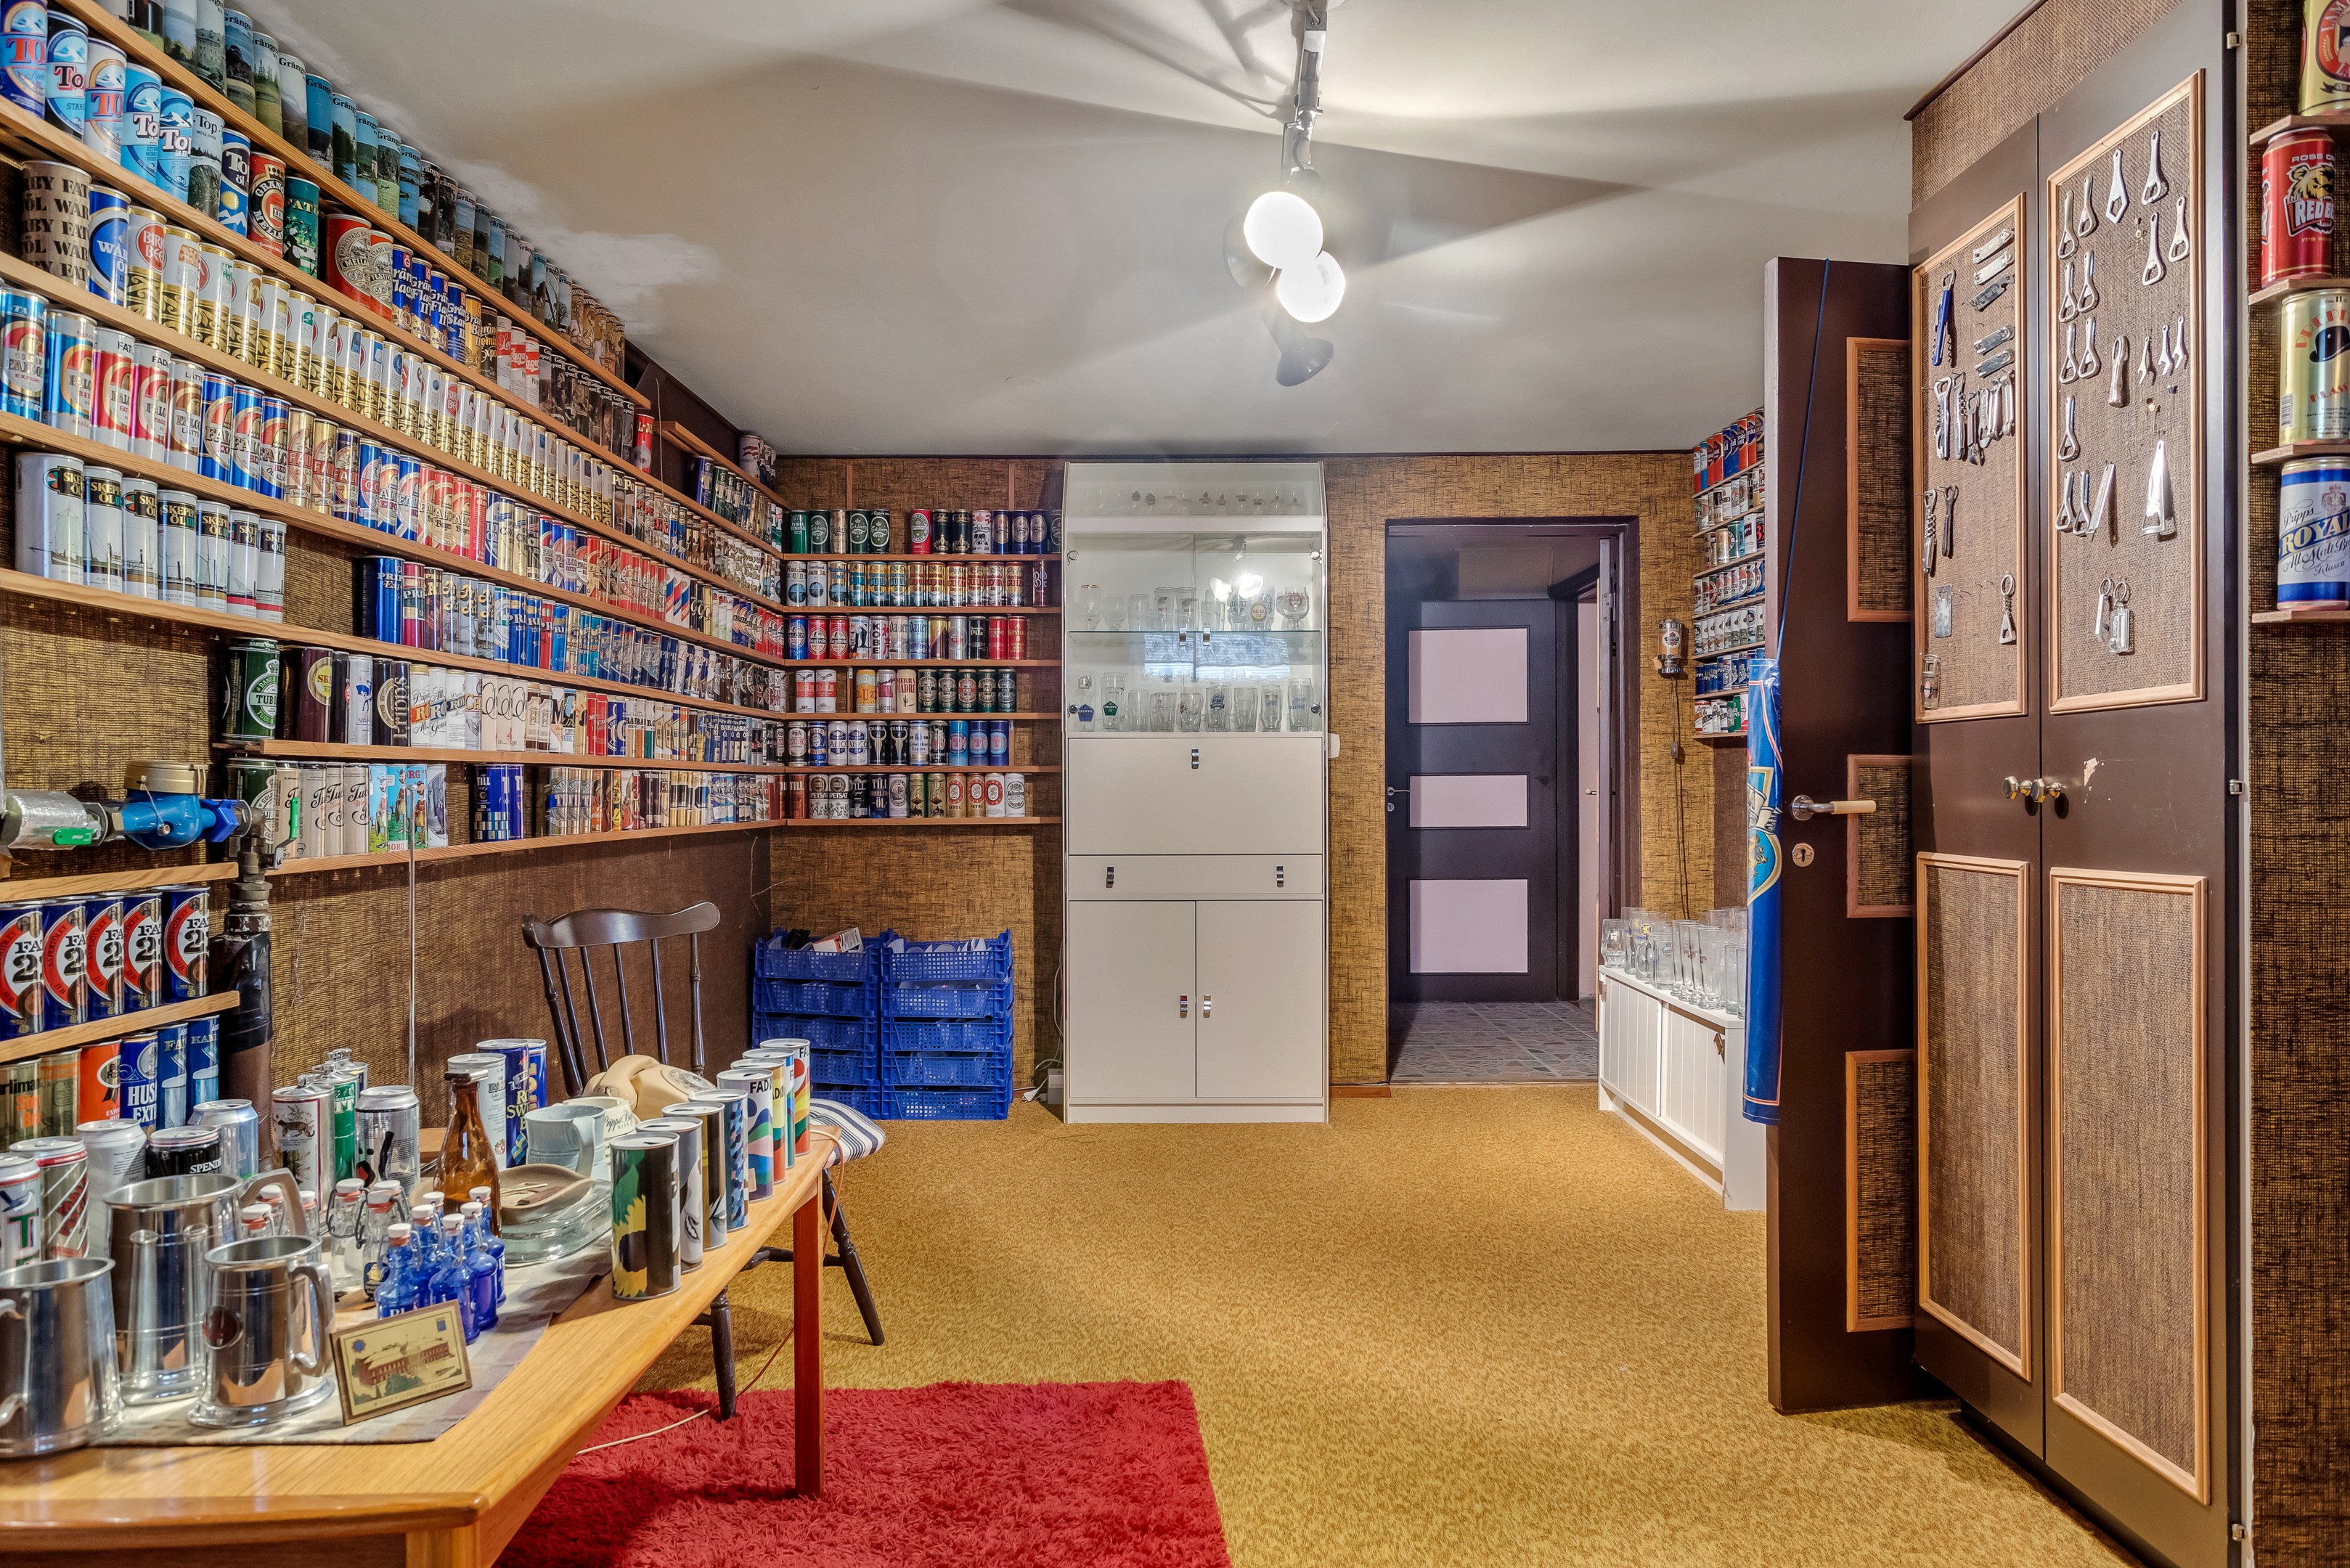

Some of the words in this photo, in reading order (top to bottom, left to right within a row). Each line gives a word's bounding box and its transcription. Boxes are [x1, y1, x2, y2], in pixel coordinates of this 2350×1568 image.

[7, 38, 46, 64] TO
[279, 57, 305, 73] Gräng
[54, 65, 85, 91] To
[91, 93, 123, 116] TO
[133, 114, 159, 138] To
[196, 114, 217, 134] Top
[226, 151, 249, 174] To
[2295, 200, 2324, 227] RED
[2324, 203, 2334, 219] BE
[205, 425, 231, 444] FAL
[234, 435, 261, 454] FAL
[259, 446, 287, 465] FALC
[290, 453, 312, 469] FAL
[63, 472, 83, 484] SKE
[91, 481, 121, 495] SKEPP
[139, 495, 158, 507] SKE
[163, 505, 195, 518] SKEPP
[2282, 502, 2316, 531] Pripps
[203, 515, 228, 528] SKEPP
[240, 525, 257, 535] SKE
[2282, 512, 2350, 557] ROYAL
[65, 934, 86, 947] FA
